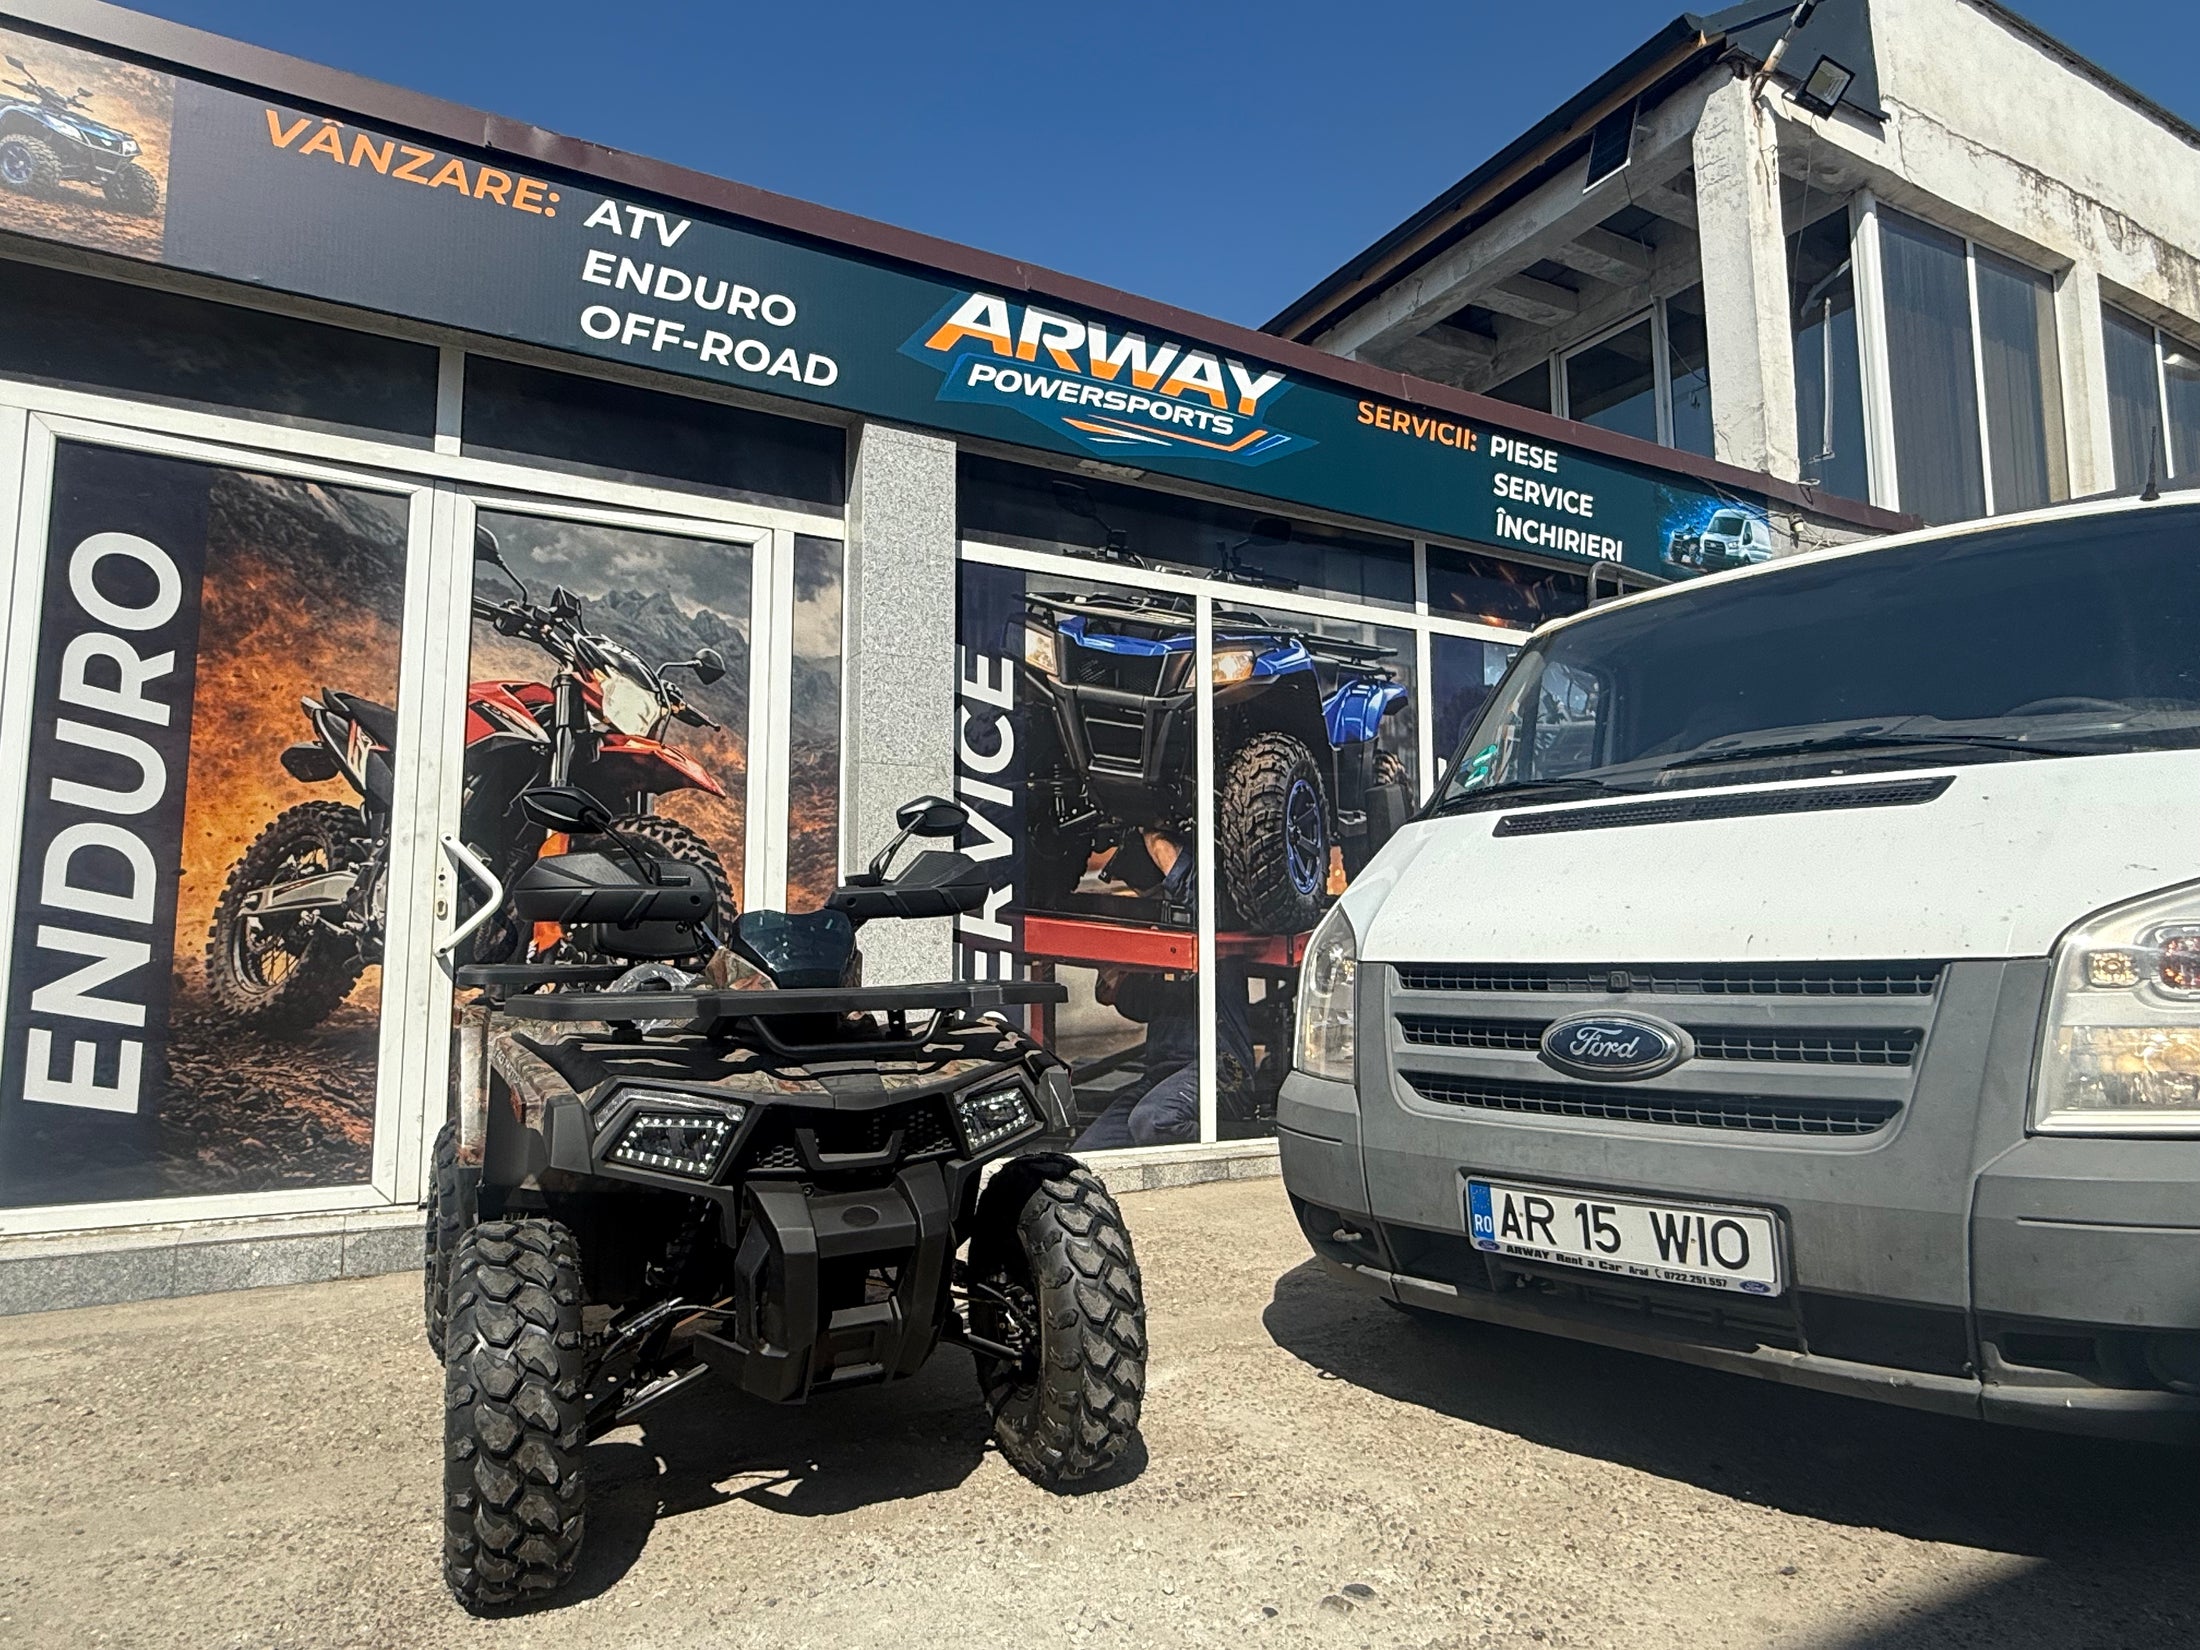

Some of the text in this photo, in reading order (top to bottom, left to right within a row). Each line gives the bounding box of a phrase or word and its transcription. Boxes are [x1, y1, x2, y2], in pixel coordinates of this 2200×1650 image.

[266, 108, 560, 217] VÂNZARE:
[584, 199, 692, 248] ATV
[582, 251, 797, 327] ENDURO
[581, 305, 838, 387] OFF-ROAD
[925, 292, 1285, 416] ARWAY
[967, 362, 1235, 437] POWERSPORTS
[1358, 401, 1478, 453] SERVICII:
[1490, 434, 1558, 474] PIESE
[1494, 472, 1594, 518] SERVICE
[1496, 506, 1623, 563] ÎNCHIRIERI
[23, 531, 182, 1114] ENDURO
[1569, 1026, 1641, 1058] Ford
[1475, 1213, 1493, 1234] RO
[1501, 1193, 1750, 1270] AR 15 WIO
[1506, 1245, 1551, 1260] ARWAY
[1556, 1253, 1584, 1266] Rent
[1587, 1260, 1595, 1268] a
[1599, 1261, 1622, 1272] Car
[1629, 1266, 1649, 1277] Arad
